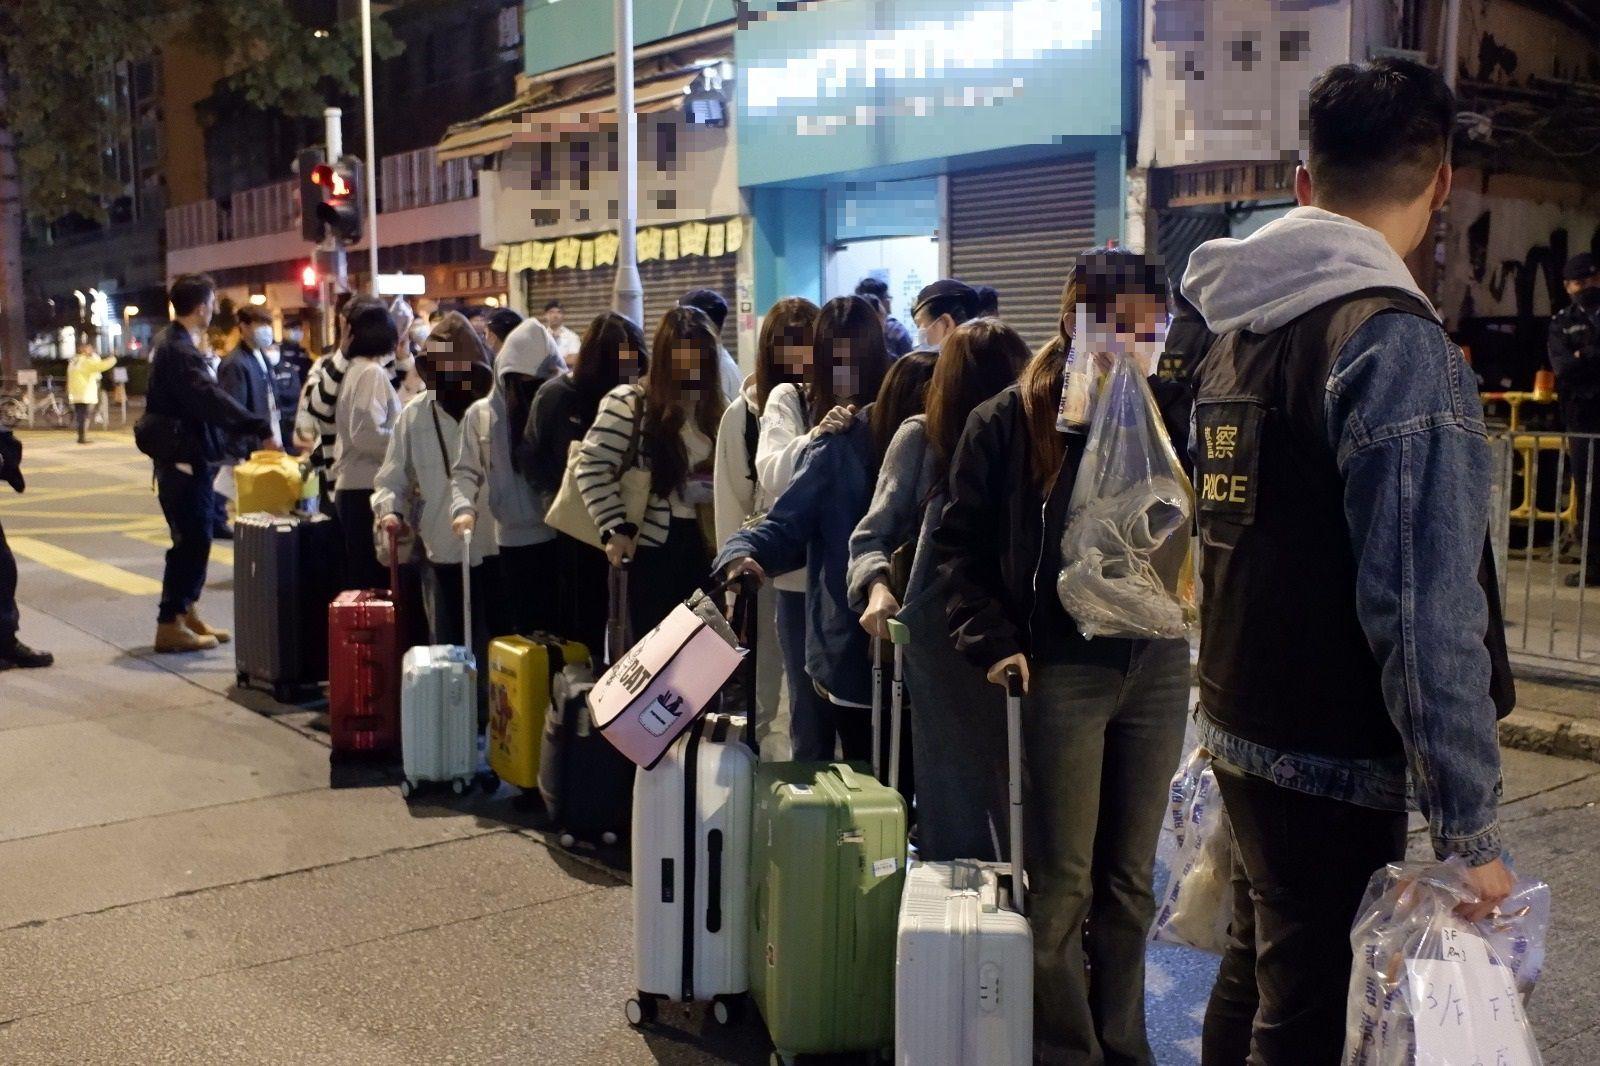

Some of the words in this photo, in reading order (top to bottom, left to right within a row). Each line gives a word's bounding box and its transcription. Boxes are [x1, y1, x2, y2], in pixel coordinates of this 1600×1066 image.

[1204, 424, 1238, 459] 警察
[619, 658, 652, 695] CAT
[1443, 929, 1458, 941] 3F
